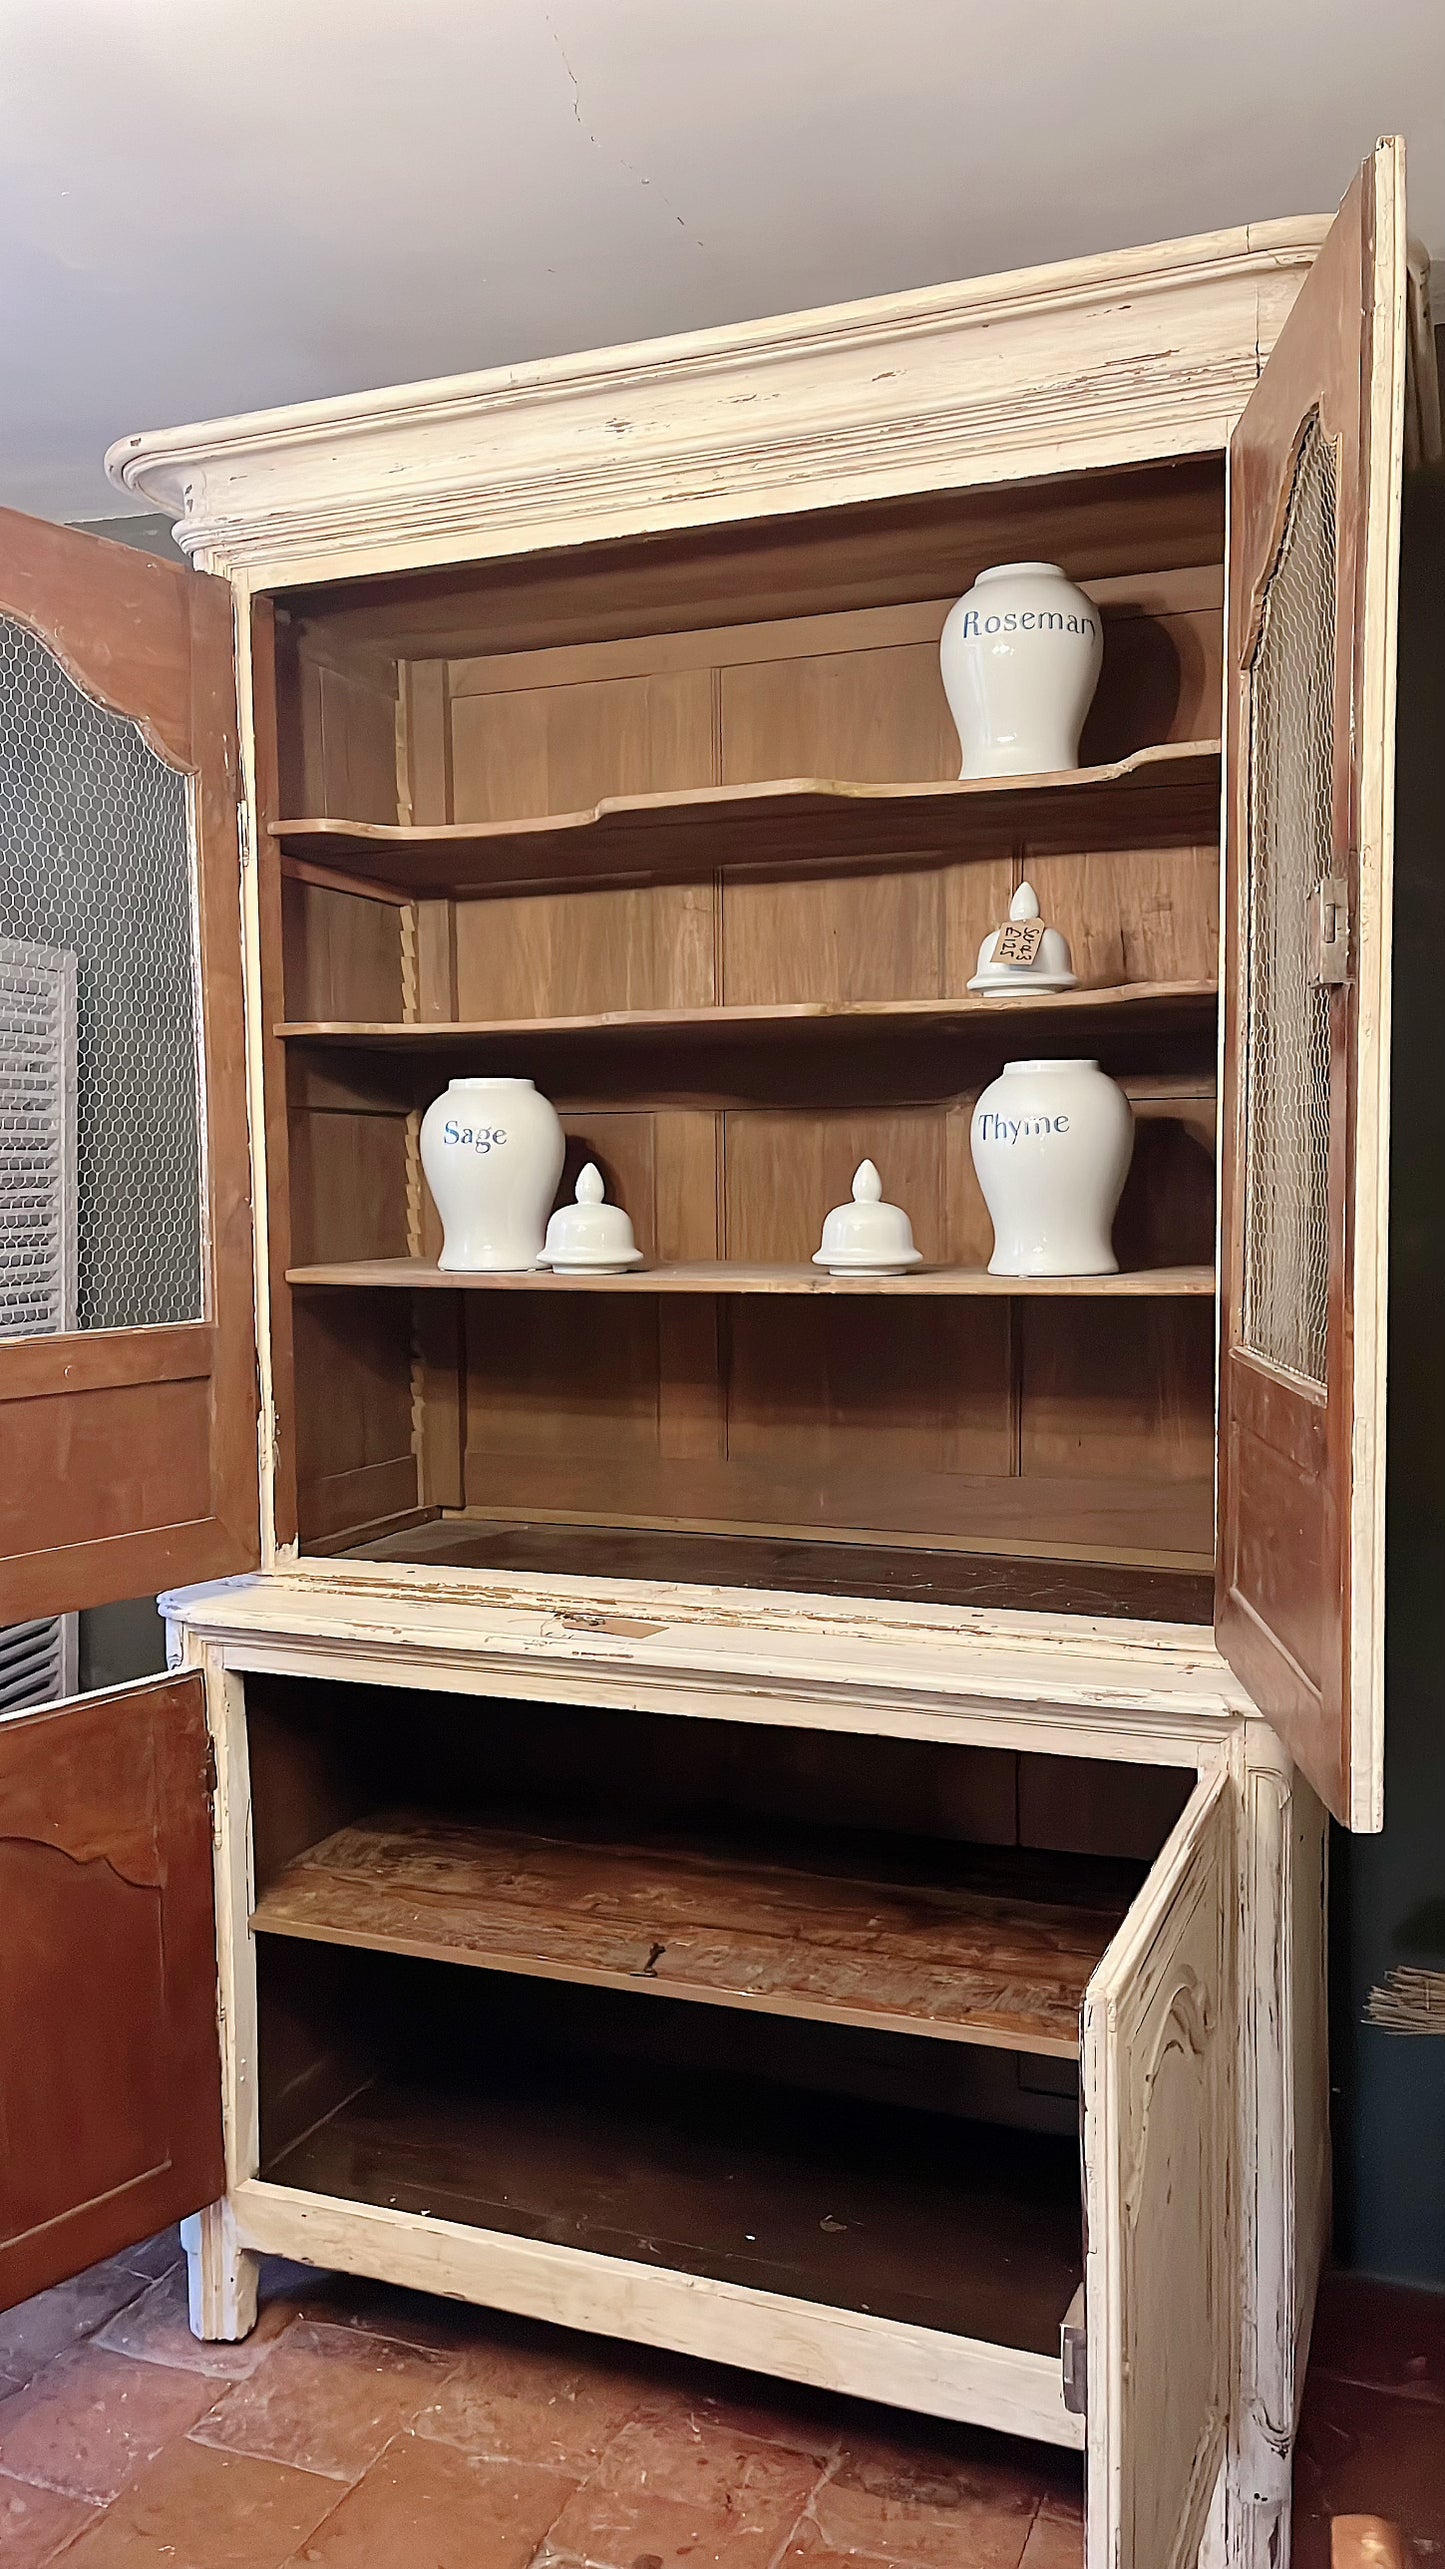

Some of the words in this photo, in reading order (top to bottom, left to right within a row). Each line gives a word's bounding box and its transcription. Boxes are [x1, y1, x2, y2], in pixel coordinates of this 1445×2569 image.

[1000, 927, 1022, 957] £125
[443, 1120, 508, 1154] Sage
[978, 1113, 1070, 1145] Thyme
